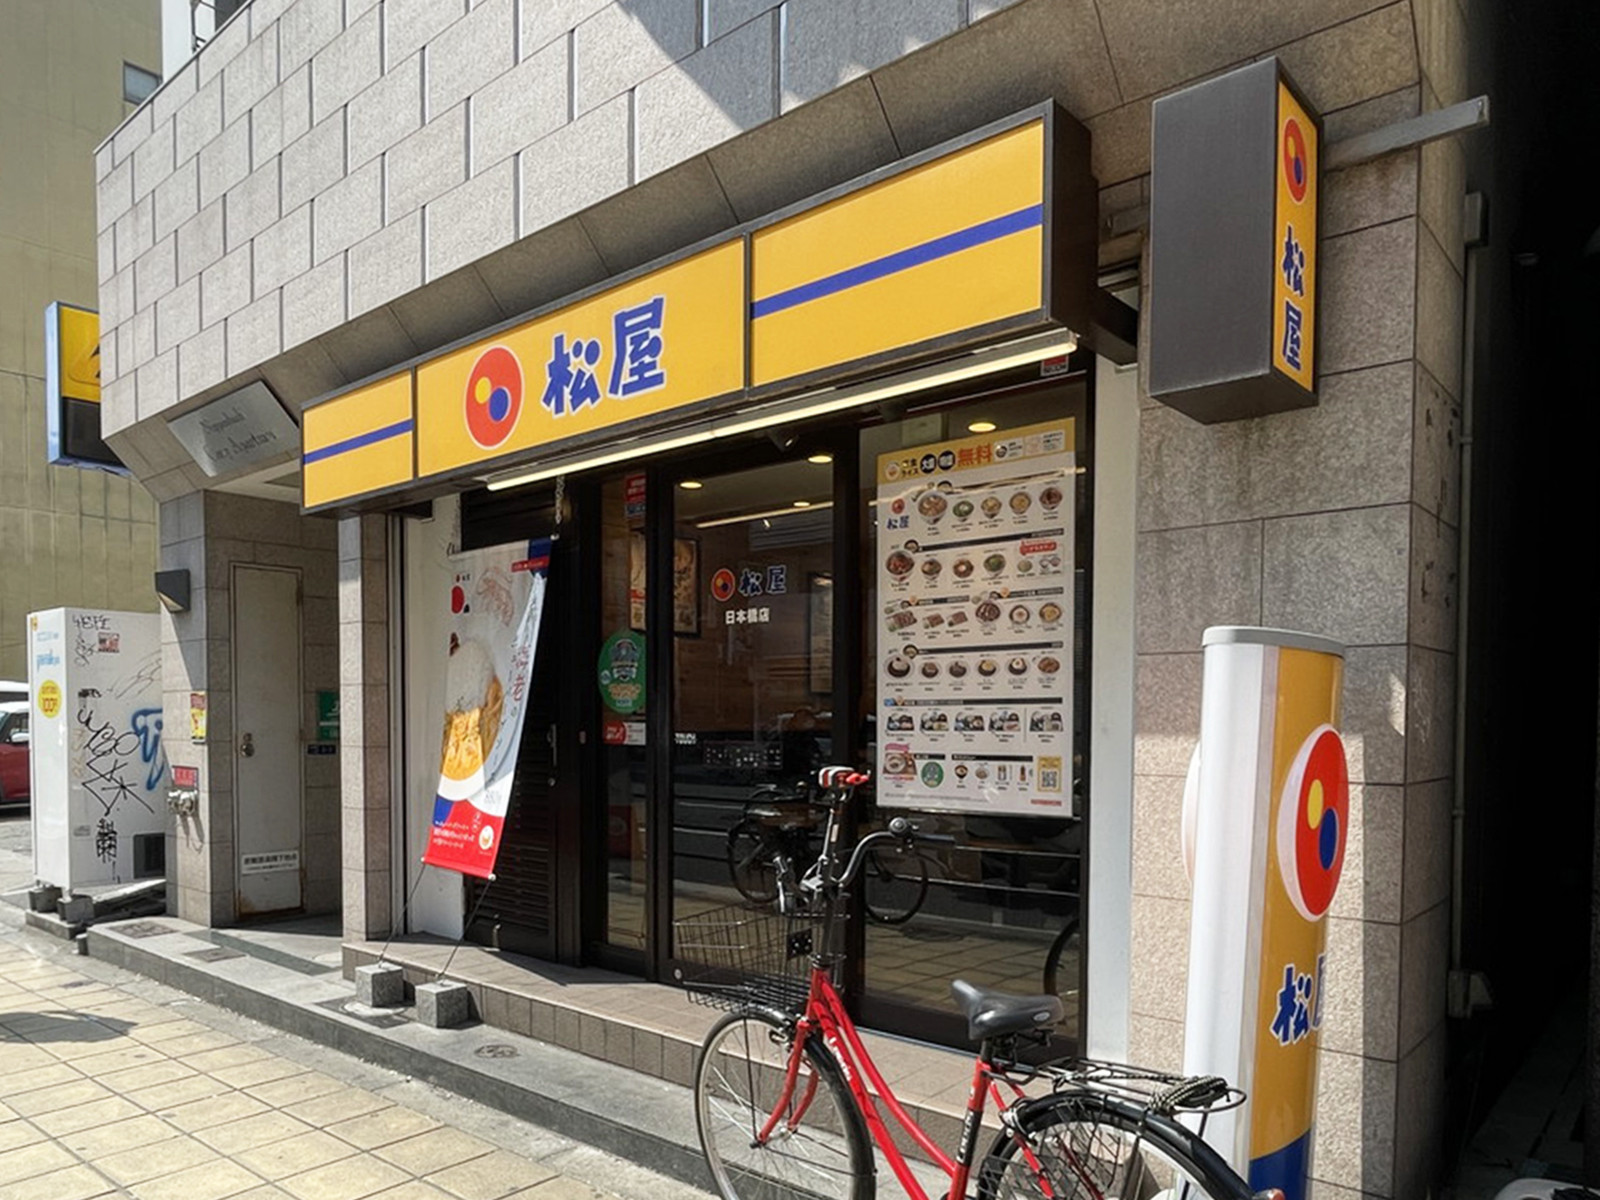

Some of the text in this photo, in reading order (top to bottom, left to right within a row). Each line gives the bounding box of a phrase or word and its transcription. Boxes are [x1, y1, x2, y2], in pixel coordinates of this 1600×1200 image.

[1282, 222, 1305, 371] 松屋
[541, 296, 665, 418] 松屋
[725, 607, 770, 625] 日本橋店
[738, 565, 787, 596] 松屋
